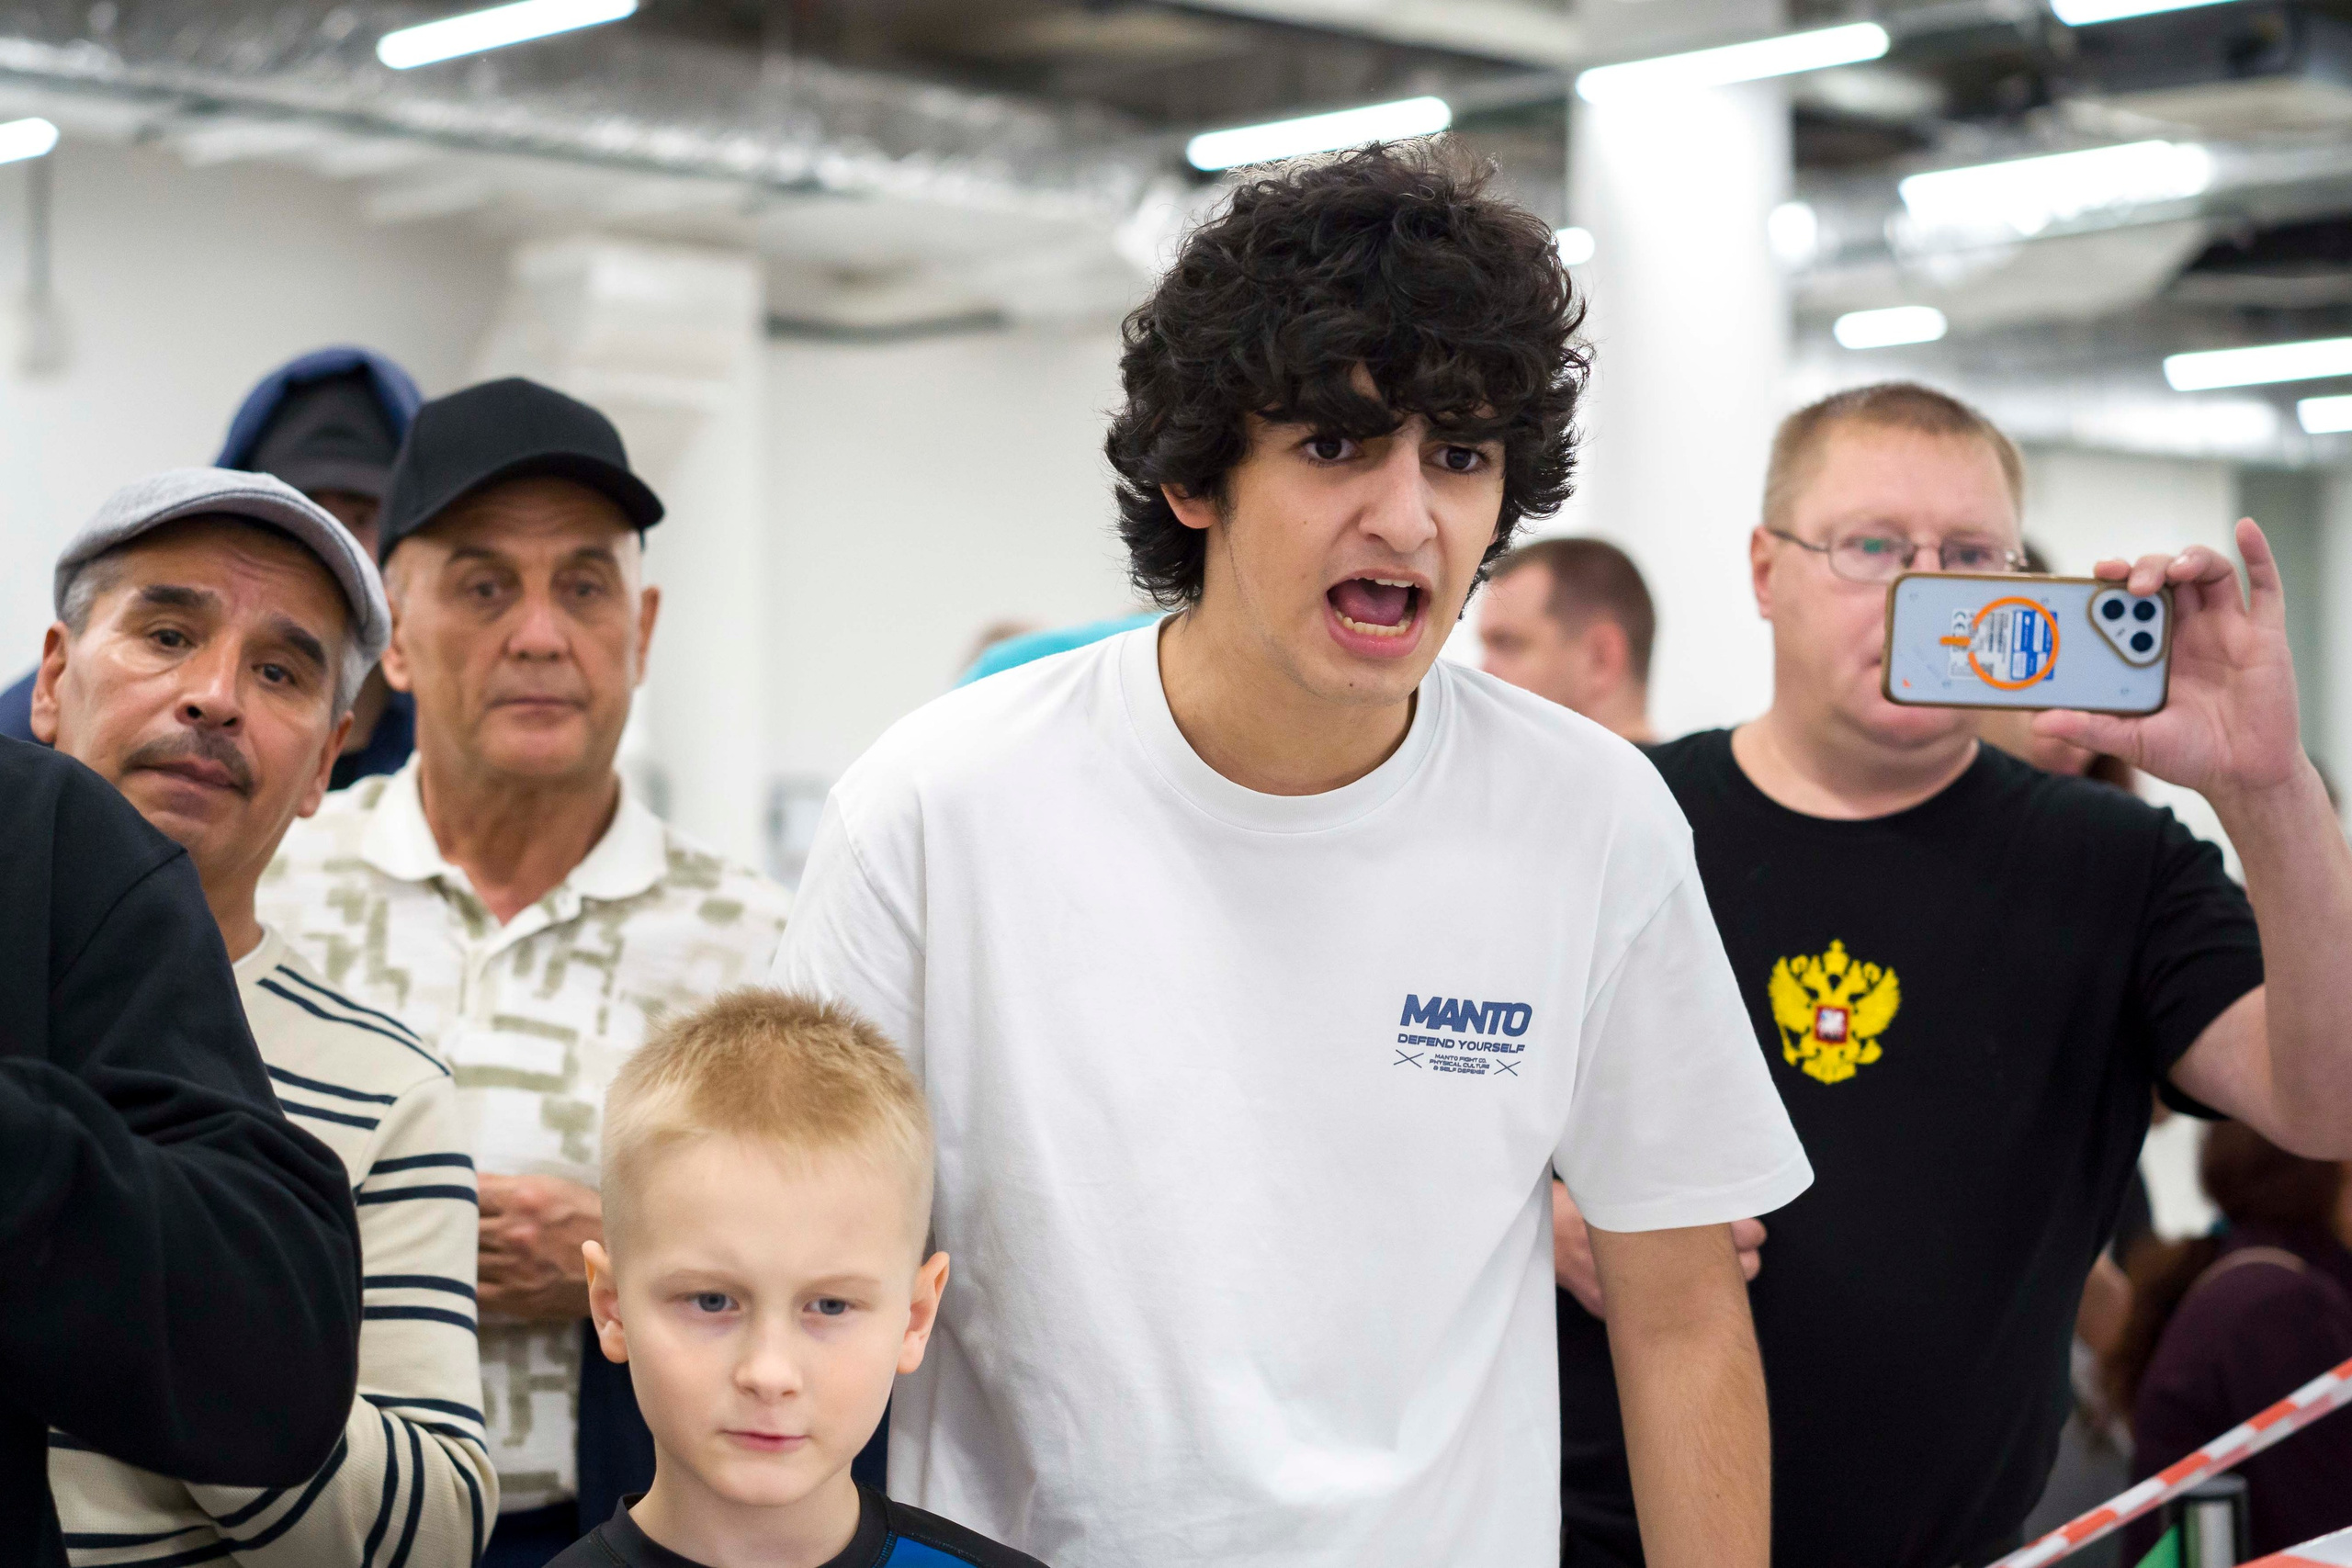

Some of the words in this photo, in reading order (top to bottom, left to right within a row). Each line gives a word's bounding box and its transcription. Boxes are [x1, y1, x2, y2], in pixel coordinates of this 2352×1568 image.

[1399, 993, 1533, 1037] MANTO
[1396, 1032, 1455, 1049] DEFEND
[1458, 1040, 1526, 1054] YOURSELF
[1429, 1058, 1462, 1067] PHYSICAL
